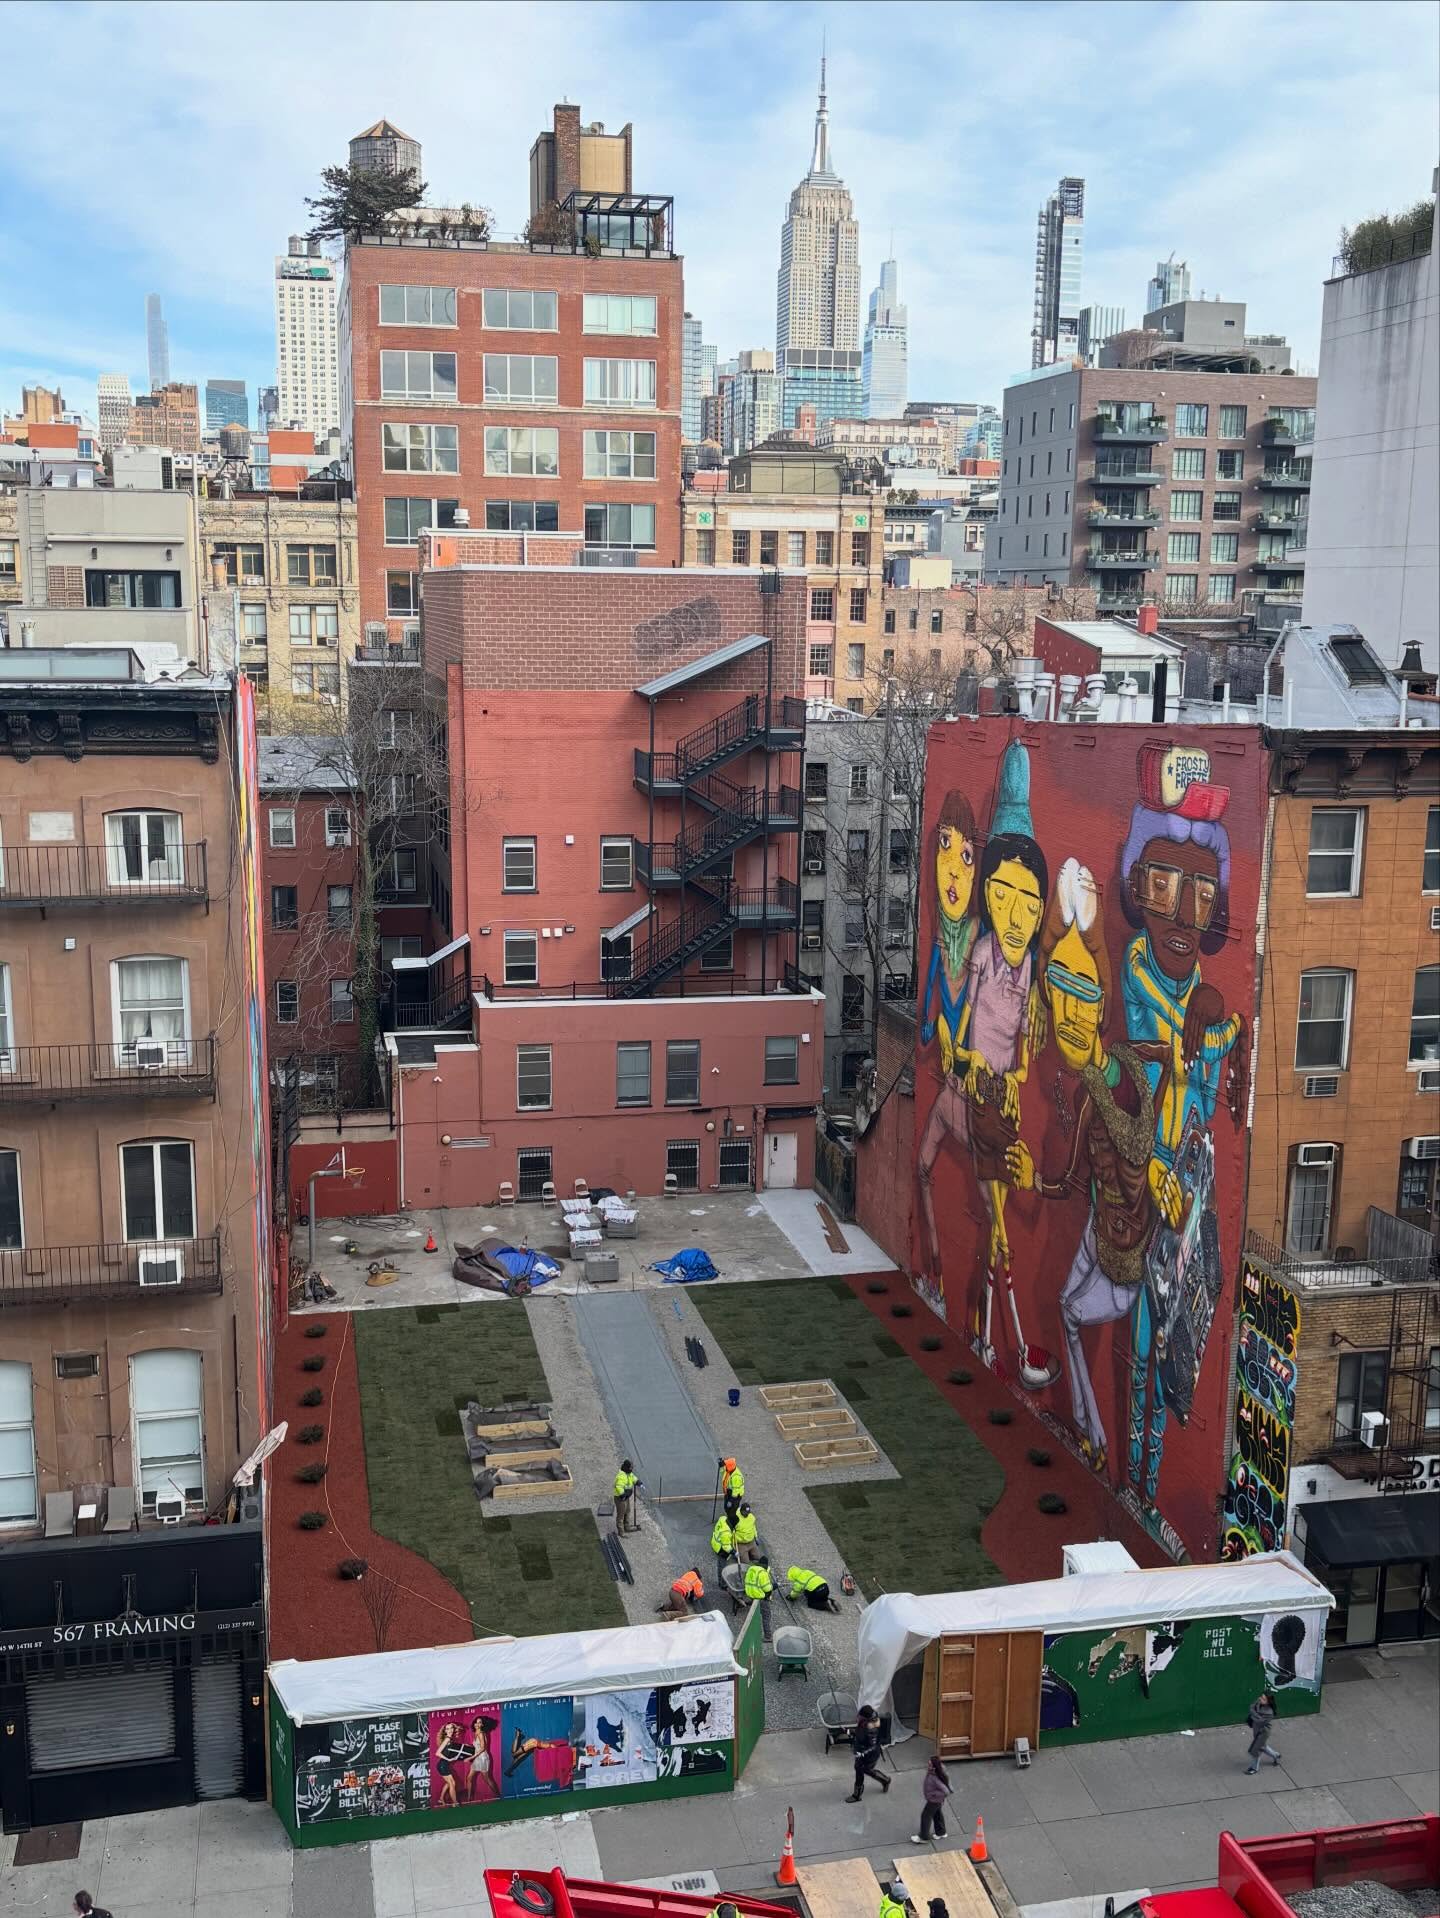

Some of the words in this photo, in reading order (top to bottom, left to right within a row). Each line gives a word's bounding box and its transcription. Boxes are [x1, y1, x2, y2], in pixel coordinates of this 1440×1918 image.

[1175, 756, 1210, 773] FROSTY
[53, 1624, 85, 1643] 567
[93, 1614, 196, 1639] FRAMING
[1205, 1627, 1233, 1639] POST
[16, 1642, 33, 1650] 14TH
[1211, 1638, 1225, 1648] NO
[1203, 1647, 1233, 1659] BILLS
[503, 1702, 529, 1710] fleur
[553, 1696, 571, 1704] mal
[431, 1710, 458, 1719] fleur
[482, 1704, 500, 1713] mal
[368, 1721, 401, 1733] PLEASE
[374, 1731, 397, 1743] POST
[374, 1742, 399, 1754] BILLS
[338, 1786, 362, 1797] POST
[338, 1796, 363, 1808] BILLS
